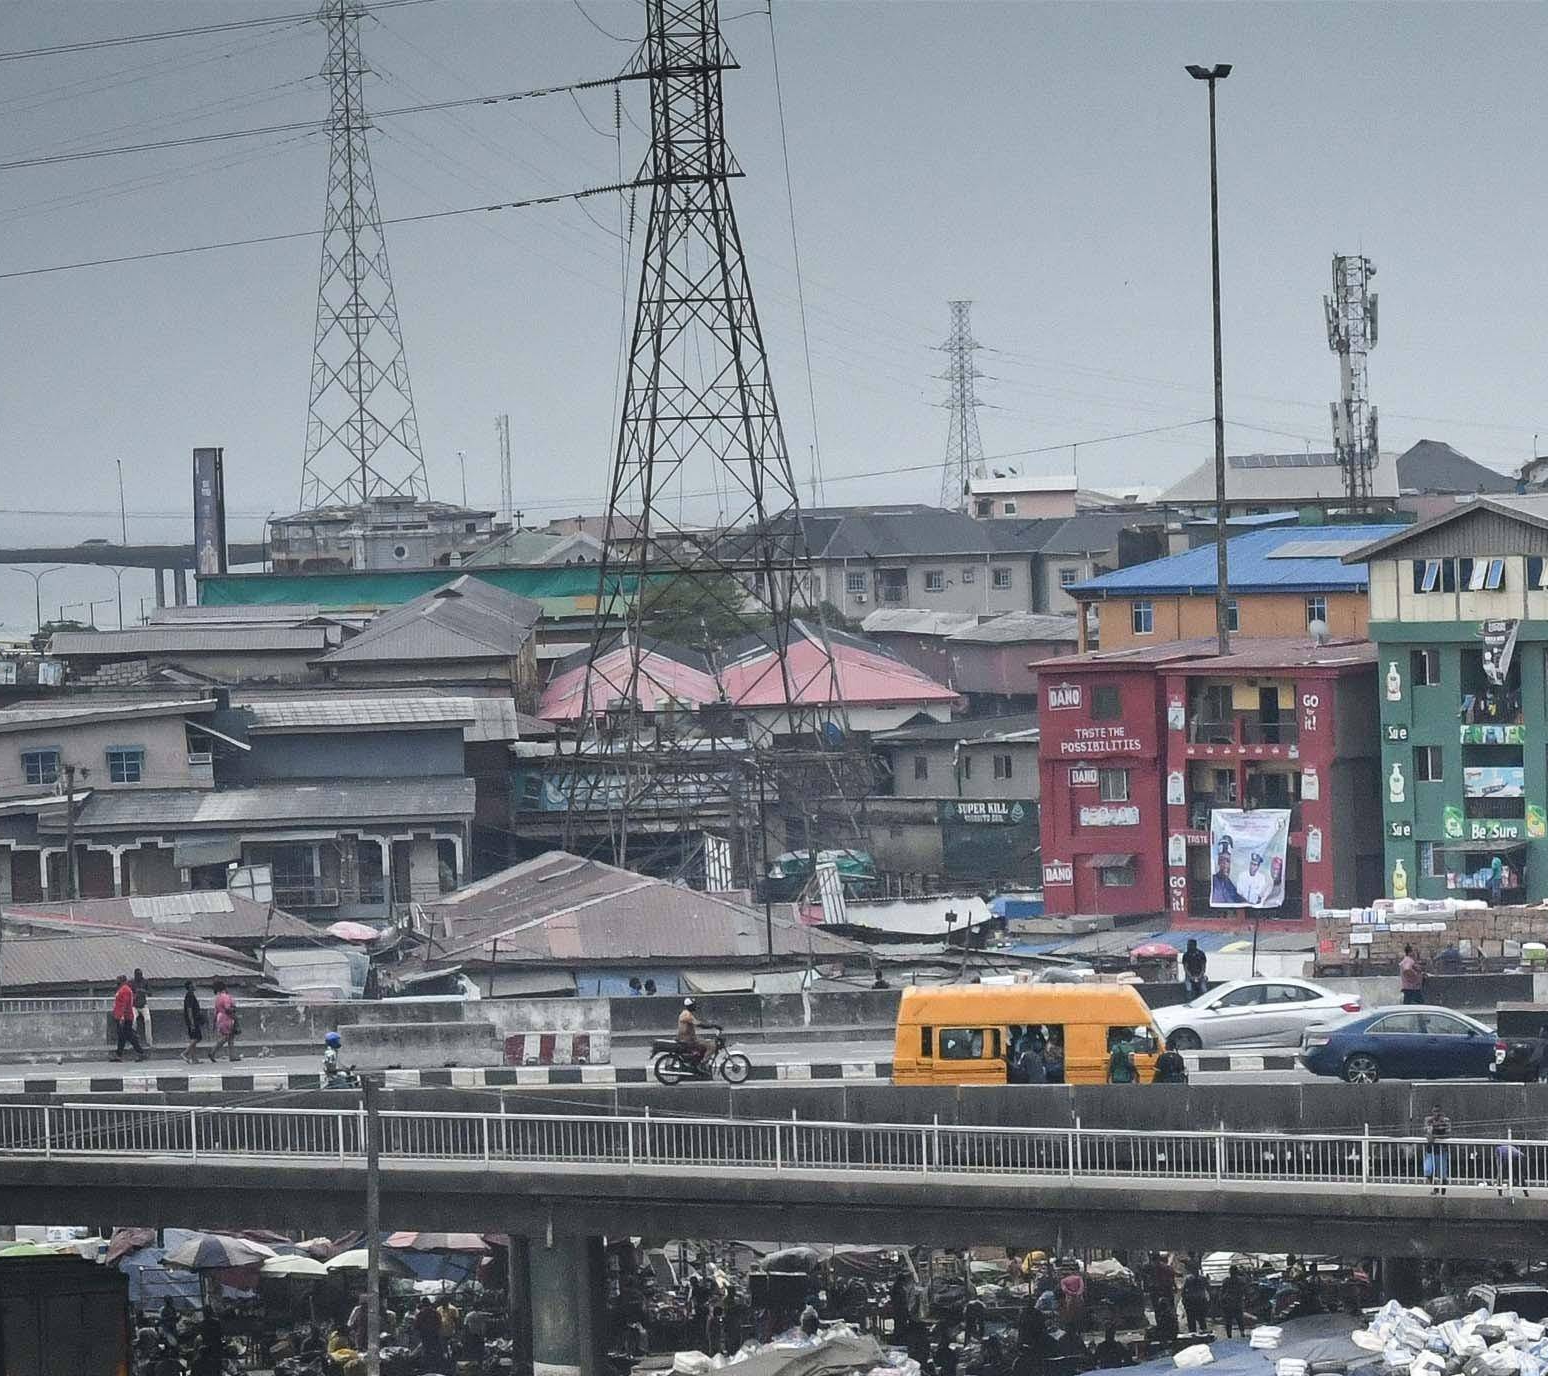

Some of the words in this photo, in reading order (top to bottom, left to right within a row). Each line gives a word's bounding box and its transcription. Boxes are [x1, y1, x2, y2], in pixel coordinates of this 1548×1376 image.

[1049, 689, 1080, 707] DANO
[1303, 694, 1319, 707] GO
[1304, 715, 1317, 732] it!
[1075, 727, 1106, 739] TASTE
[1108, 726, 1125, 737] THE
[1061, 739, 1142, 754] POSSIBILITIES
[1072, 770, 1097, 783] DANO
[958, 802, 986, 814] SUPER
[987, 802, 1008, 814] KILL
[1471, 822, 1487, 840] Be
[1493, 821, 1518, 840] Sure
[1187, 835, 1208, 844] TASTE
[1045, 868, 1071, 882] DANO
[1169, 876, 1186, 888] GO
[1172, 896, 1185, 911] it!
